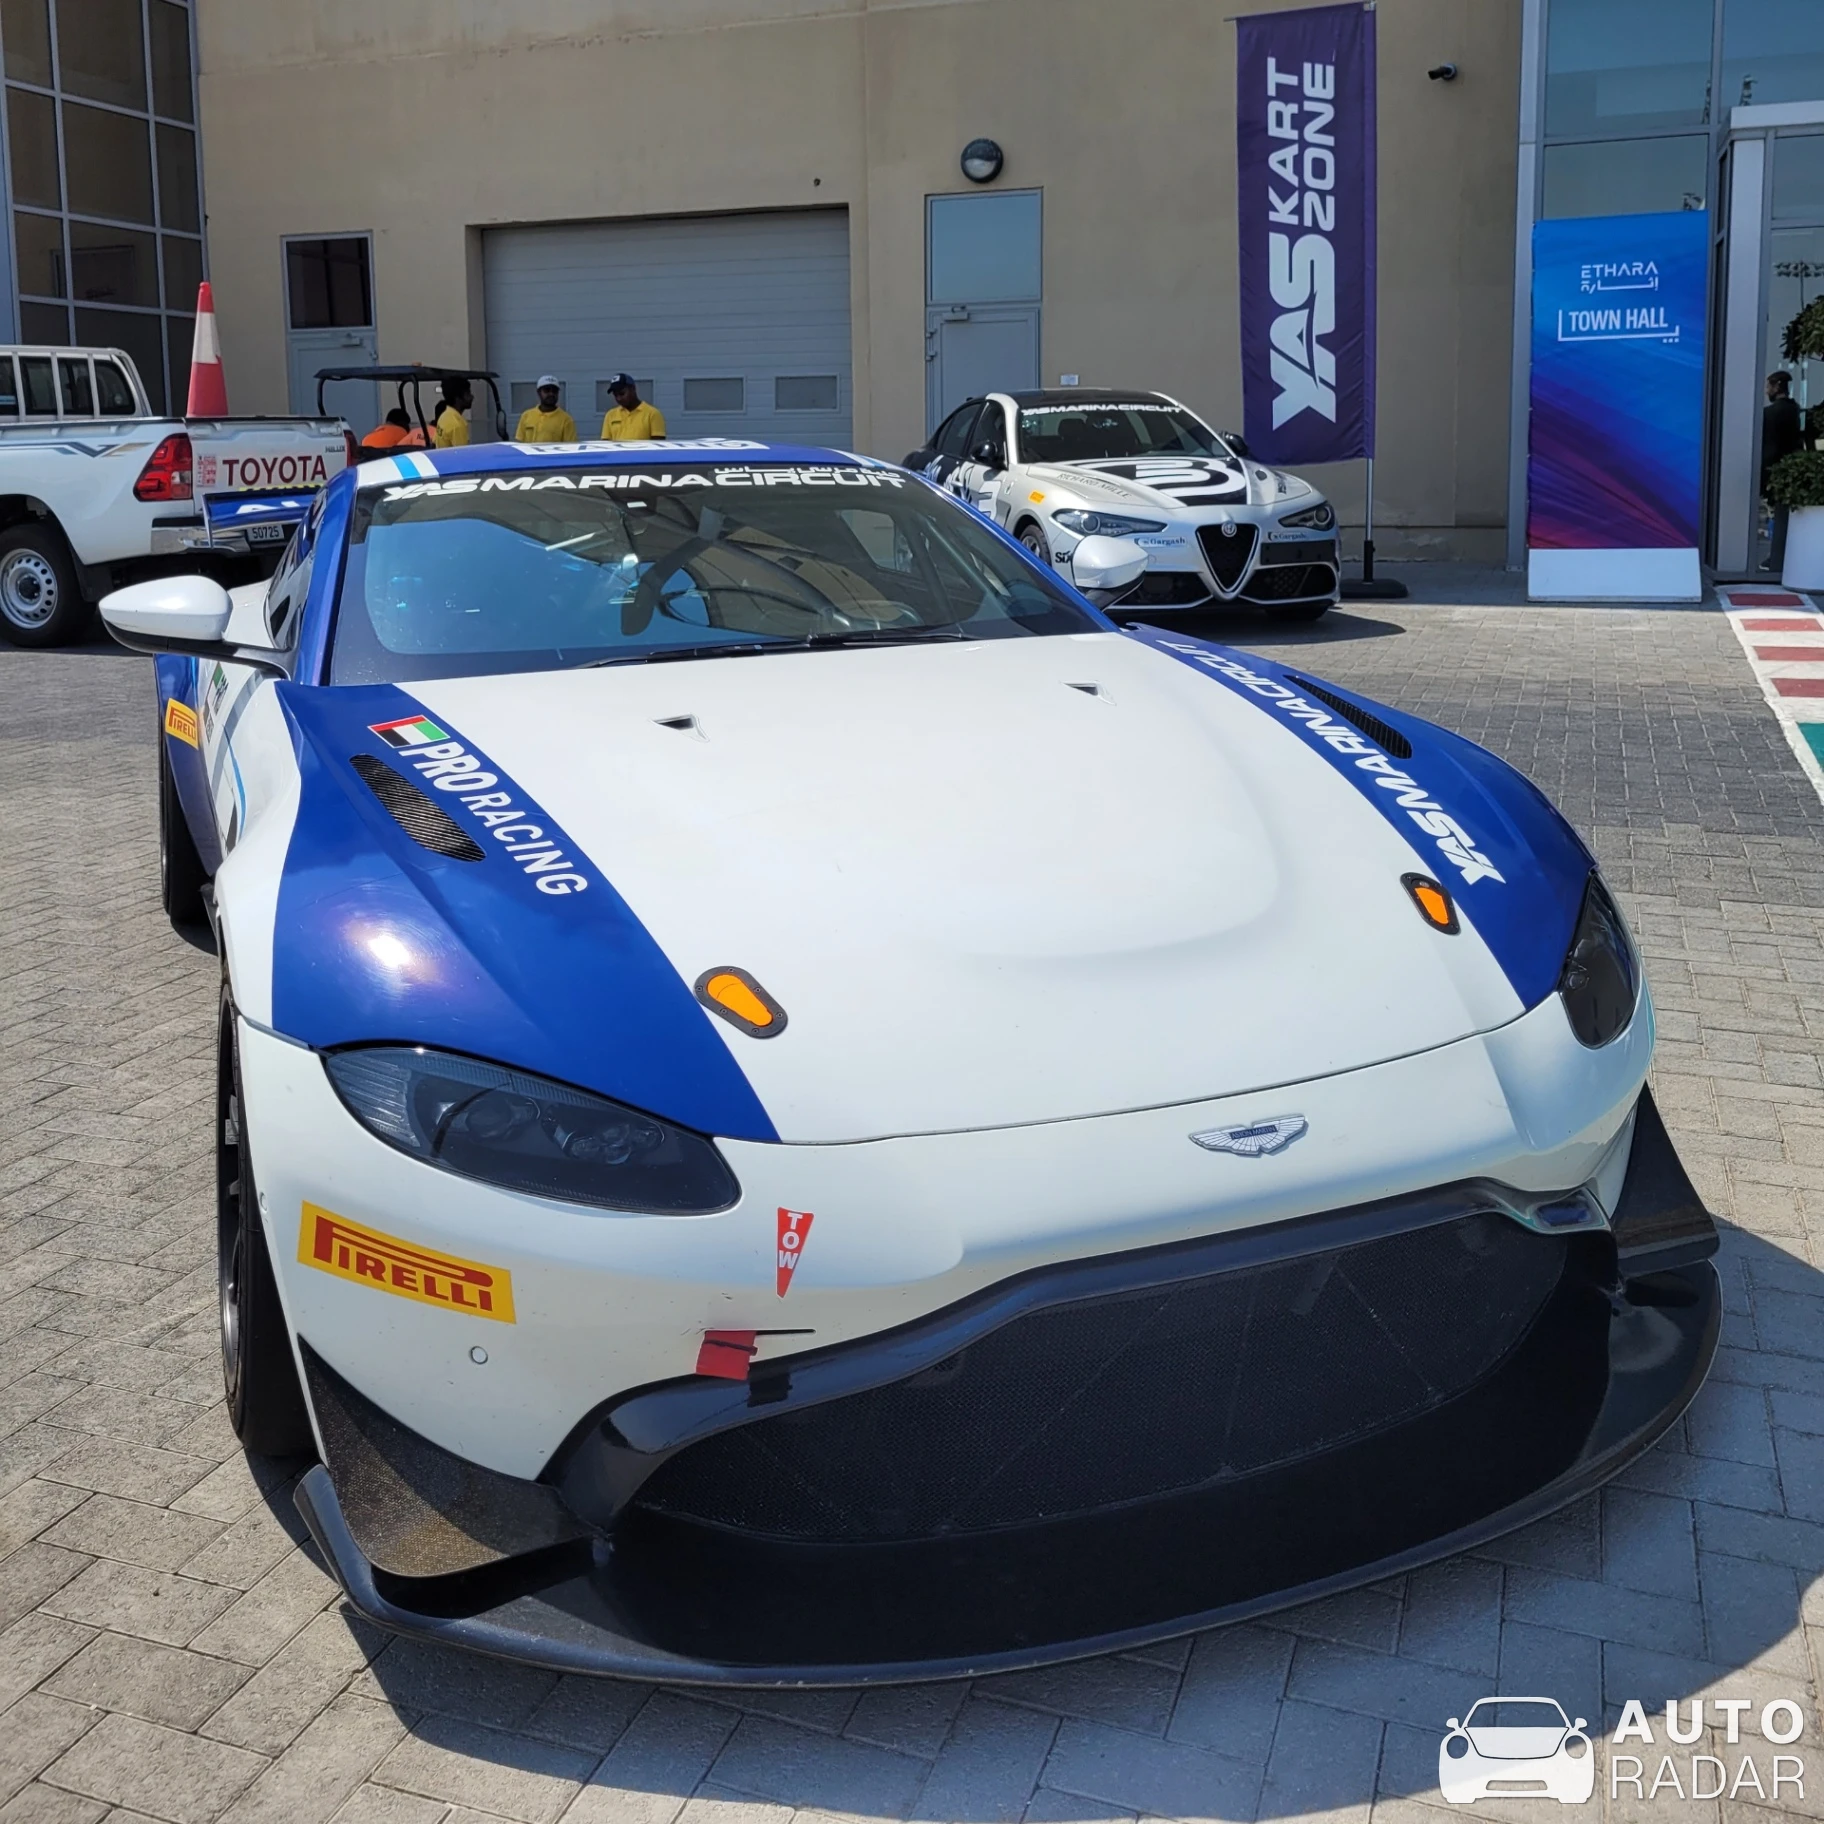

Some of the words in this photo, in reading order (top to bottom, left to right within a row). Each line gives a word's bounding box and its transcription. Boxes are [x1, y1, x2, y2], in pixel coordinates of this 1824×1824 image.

[1267, 57, 1299, 226] KART
[1303, 62, 1335, 231] ZONE
[1581, 261, 1658, 279] ETHARA
[1268, 233, 1336, 431] YAS
[1569, 309, 1621, 332] TOWN
[1626, 307, 1668, 329] HALL
[223, 455, 327, 486] TOYOTA
[252, 526, 280, 540] 50725
[398, 741, 498, 792] PRO
[459, 791, 588, 895] RACING
[313, 1215, 493, 1312] PIRELLI
[778, 1211, 802, 1271] TOW
